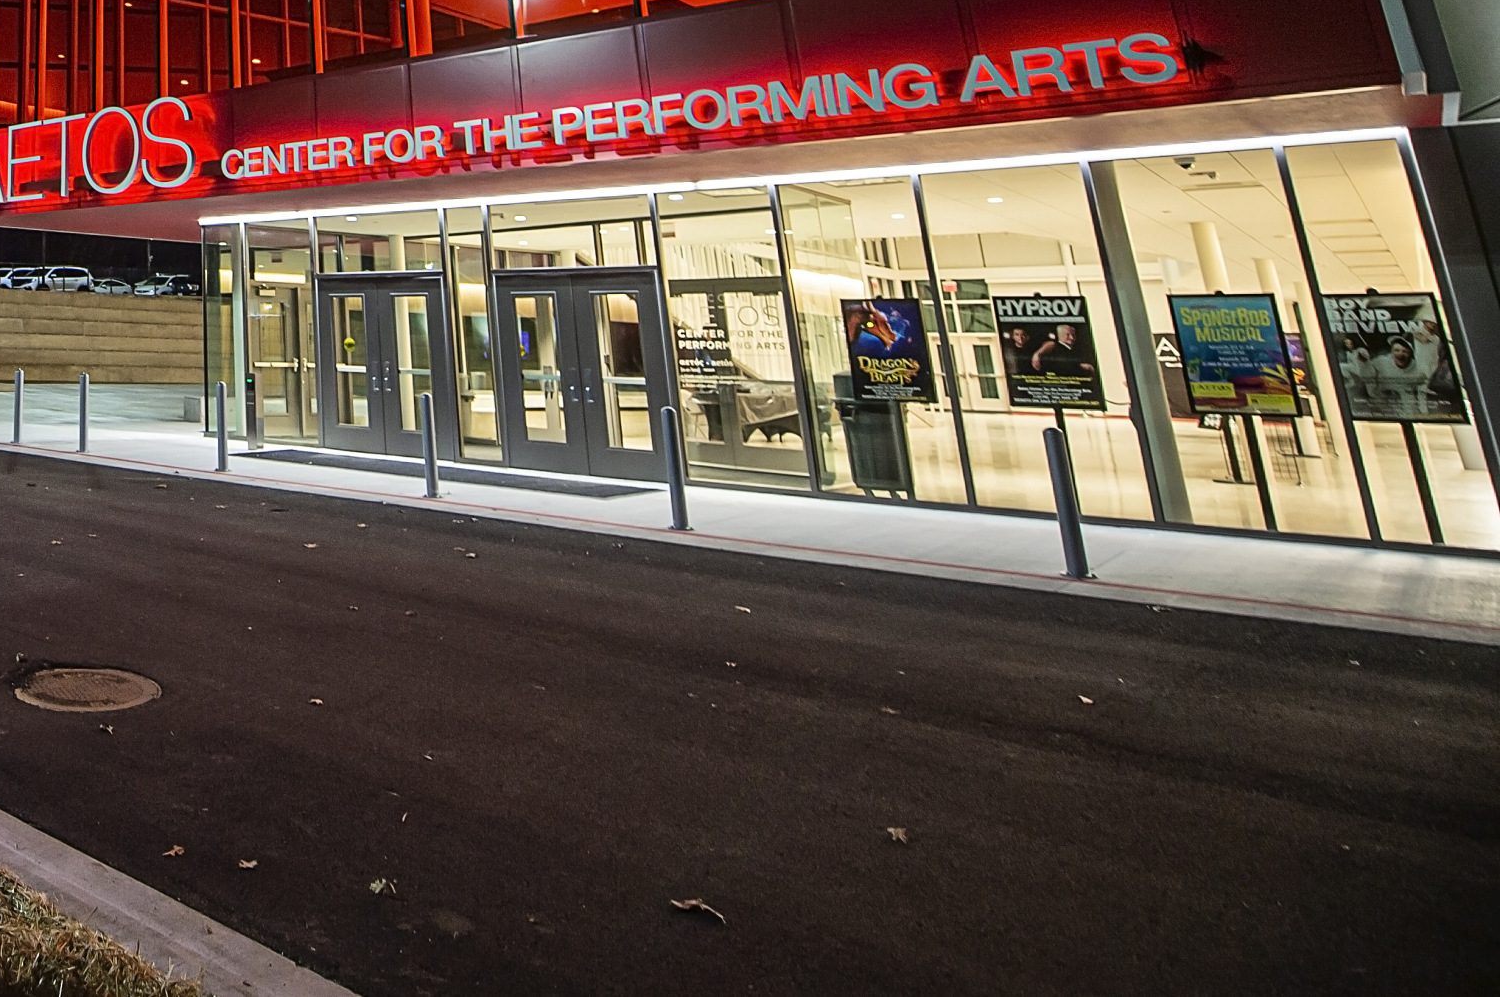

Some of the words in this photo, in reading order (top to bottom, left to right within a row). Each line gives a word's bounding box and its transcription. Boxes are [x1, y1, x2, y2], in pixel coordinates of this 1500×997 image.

[220, 134, 356, 181] CENTER
[363, 124, 447, 167] FOR
[453, 111, 542, 156] THE
[552, 62, 940, 147] PERFORMING
[959, 32, 1180, 104] ARTS
[996, 299, 1082, 316] HYPROV
[1180, 307, 1271, 327] SPONGEBOB
[677, 329, 726, 339] CENTER
[760, 330, 784, 338] THE
[1194, 326, 1265, 342] MUSICAL
[1328, 320, 1424, 334] REVIEW
[755, 342, 786, 350] ARTS
